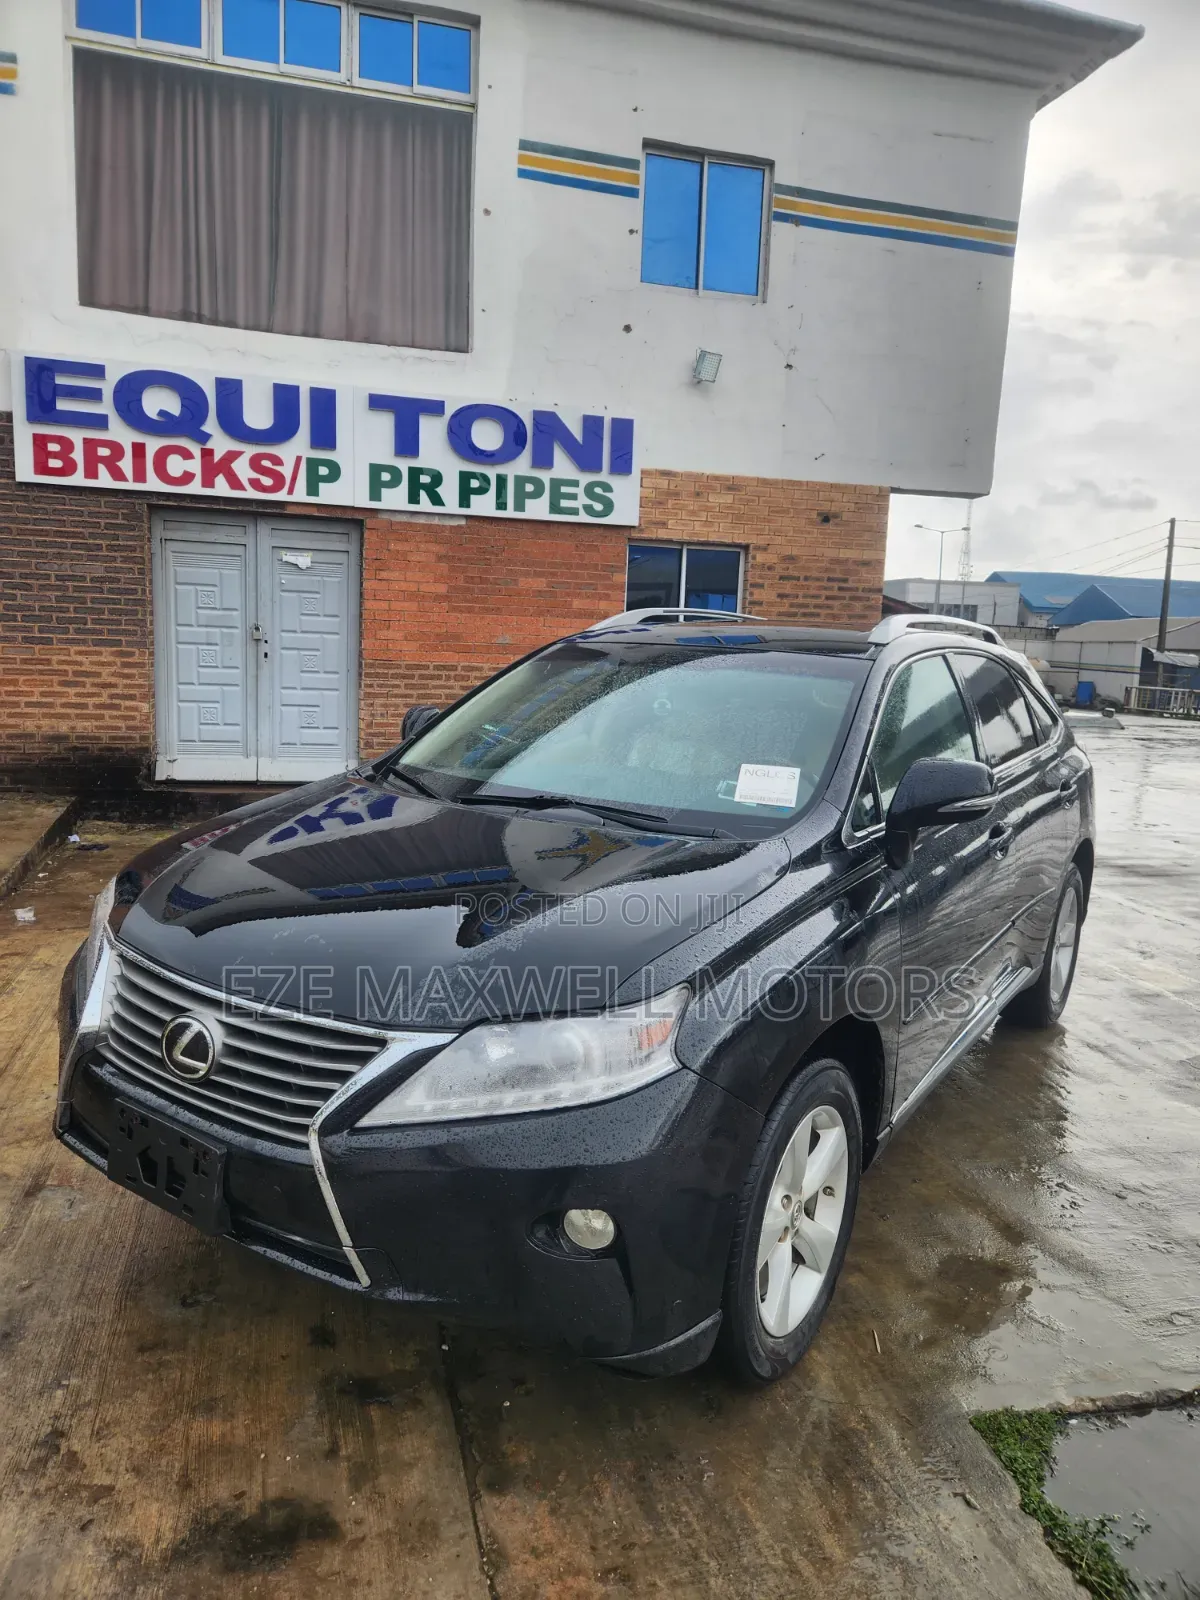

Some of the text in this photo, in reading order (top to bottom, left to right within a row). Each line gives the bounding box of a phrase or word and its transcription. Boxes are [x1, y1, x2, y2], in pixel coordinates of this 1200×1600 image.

[24, 356, 634, 476] EQUI TONI
[458, 470, 615, 519] PIPES
